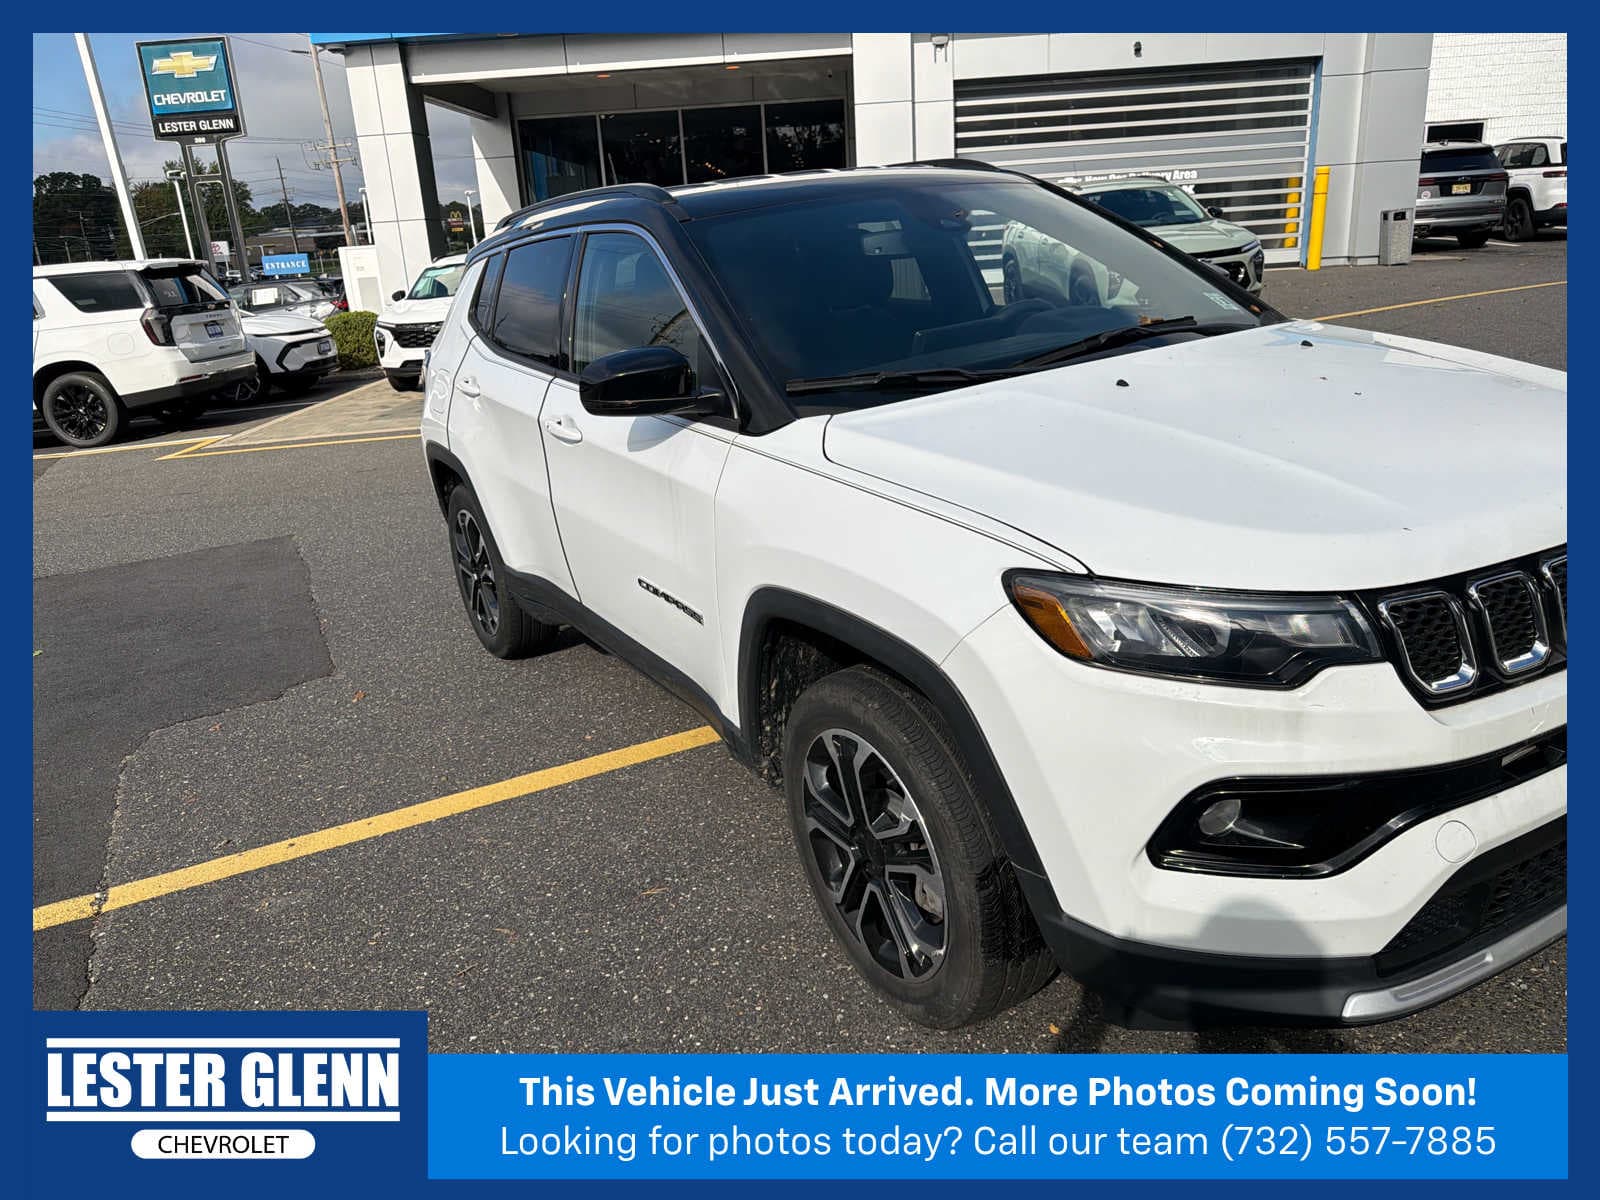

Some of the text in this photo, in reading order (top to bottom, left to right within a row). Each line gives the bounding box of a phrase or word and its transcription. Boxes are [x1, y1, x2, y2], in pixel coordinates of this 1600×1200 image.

[153, 89, 227, 106] CHEVROLET
[158, 118, 234, 133] LESTER GLENN
[1172, 169, 1198, 180] Area
[265, 260, 307, 270] ENTRANCE
[637, 578, 704, 625] COMPASS
